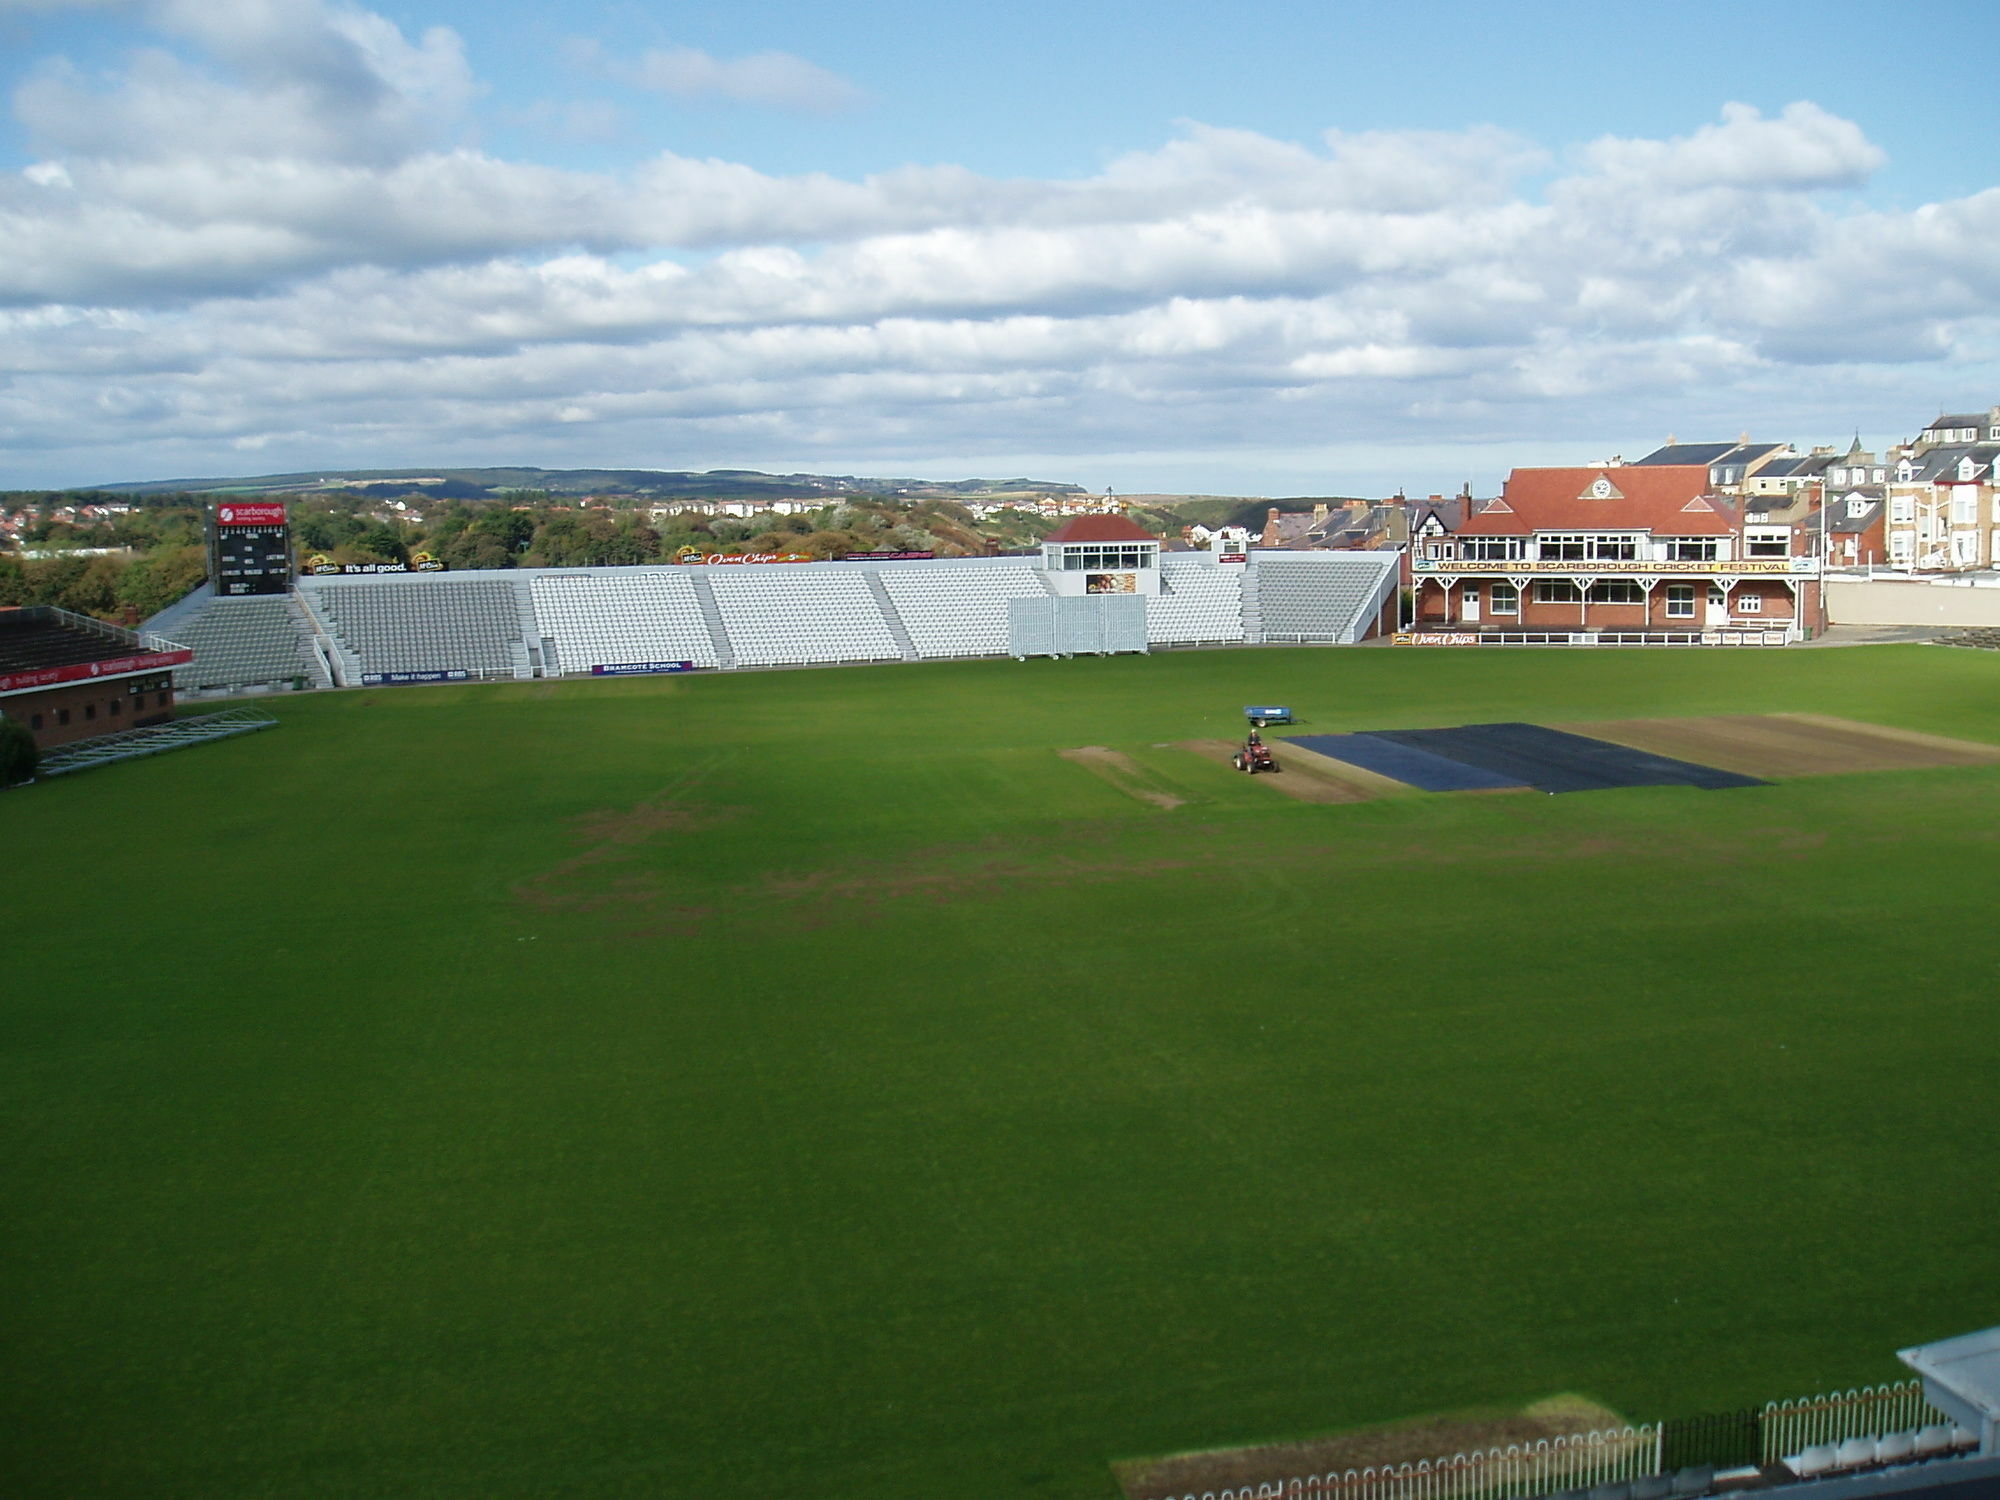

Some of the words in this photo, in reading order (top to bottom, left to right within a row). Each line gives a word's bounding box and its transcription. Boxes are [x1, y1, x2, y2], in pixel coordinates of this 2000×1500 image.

[235, 507, 284, 518] scarborough
[708, 553, 741, 565] Oven
[742, 553, 777, 565] Chips
[362, 563, 376, 573] all
[1437, 562, 1509, 570] WELCOME
[1512, 562, 1532, 570] TO
[1536, 562, 1648, 571] SCARBOROUGH
[1653, 563, 1716, 571] CRICKET
[1720, 563, 1789, 571] FESTIVAL
[603, 663, 648, 672] BRAMCOTE
[649, 662, 682, 670] SCHOOL
